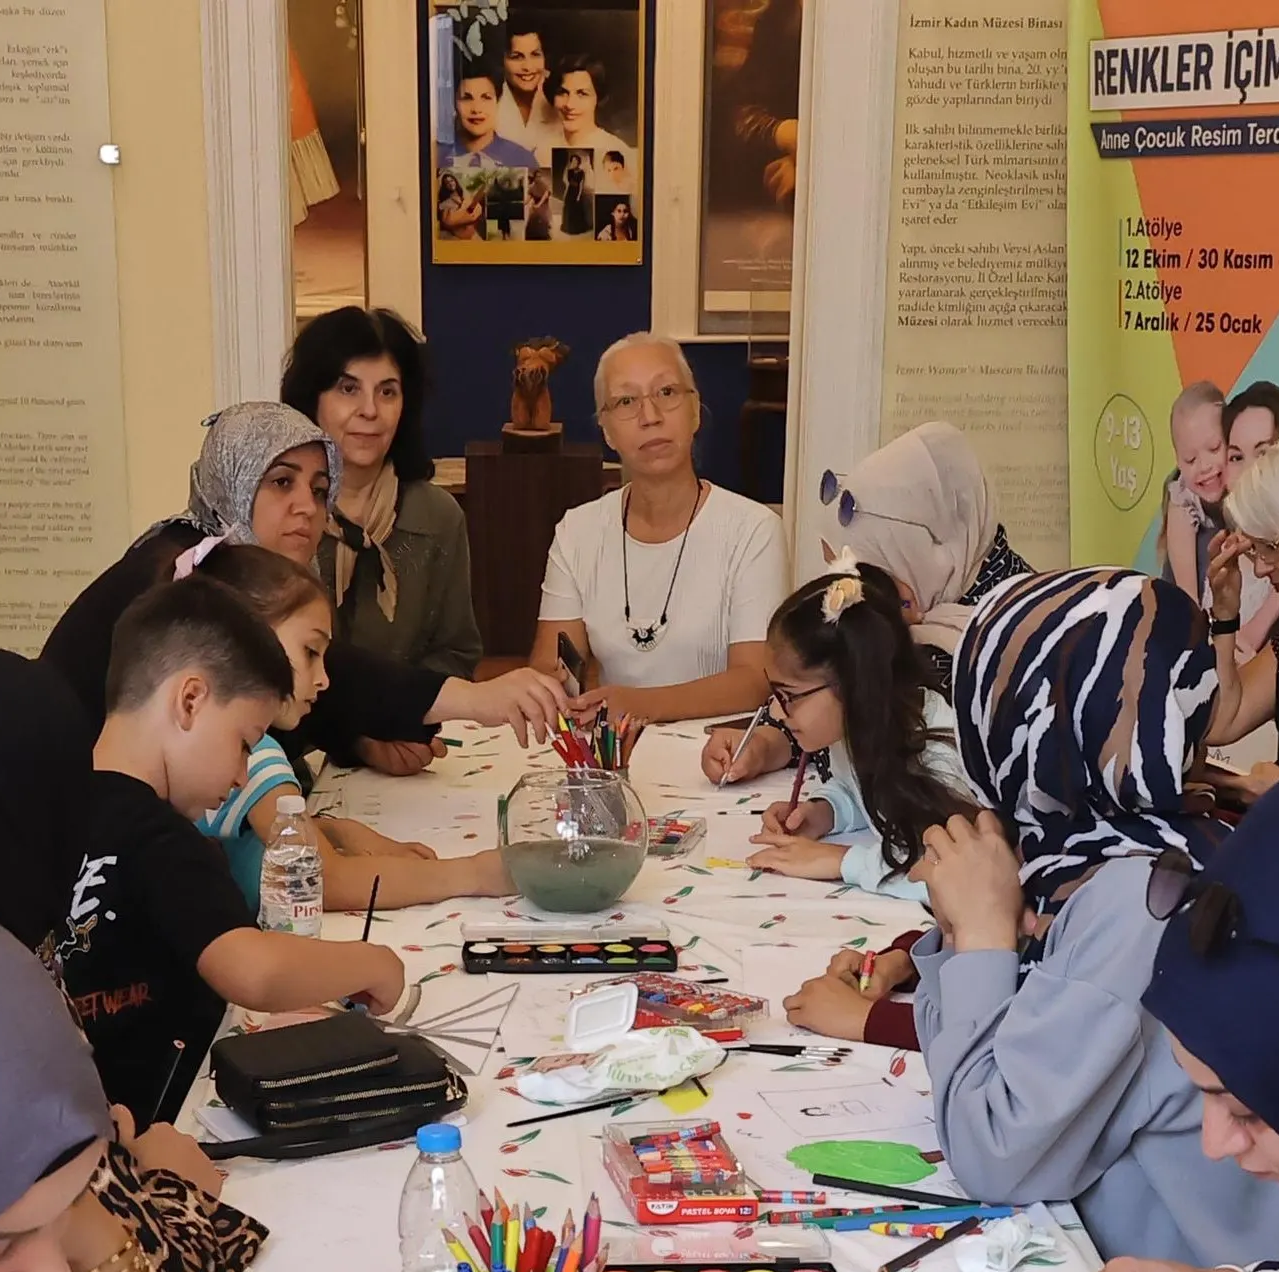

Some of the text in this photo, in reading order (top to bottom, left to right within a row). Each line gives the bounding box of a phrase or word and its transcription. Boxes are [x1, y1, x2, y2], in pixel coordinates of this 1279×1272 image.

[944, 17, 979, 28] Kadın
[983, 17, 1023, 29] Müzesi
[1028, 17, 1063, 29] Binası
[1094, 43, 1214, 96] RENKLER
[1100, 129, 1130, 149] Anne
[1135, 125, 1186, 153] Çocuk
[1191, 124, 1242, 147] Resim
[1126, 217, 1183, 240] 1.Atölye
[1126, 249, 1273, 269] 12 Ekim / 30 Kasım
[1125, 280, 1182, 304] 2.Atölye
[898, 316, 938, 326] Müzesi
[1124, 311, 1262, 333] 7 Aralık / 25 Ocak
[1105, 411, 1141, 449] 9-13
[1110, 455, 1137, 497] Yaş
